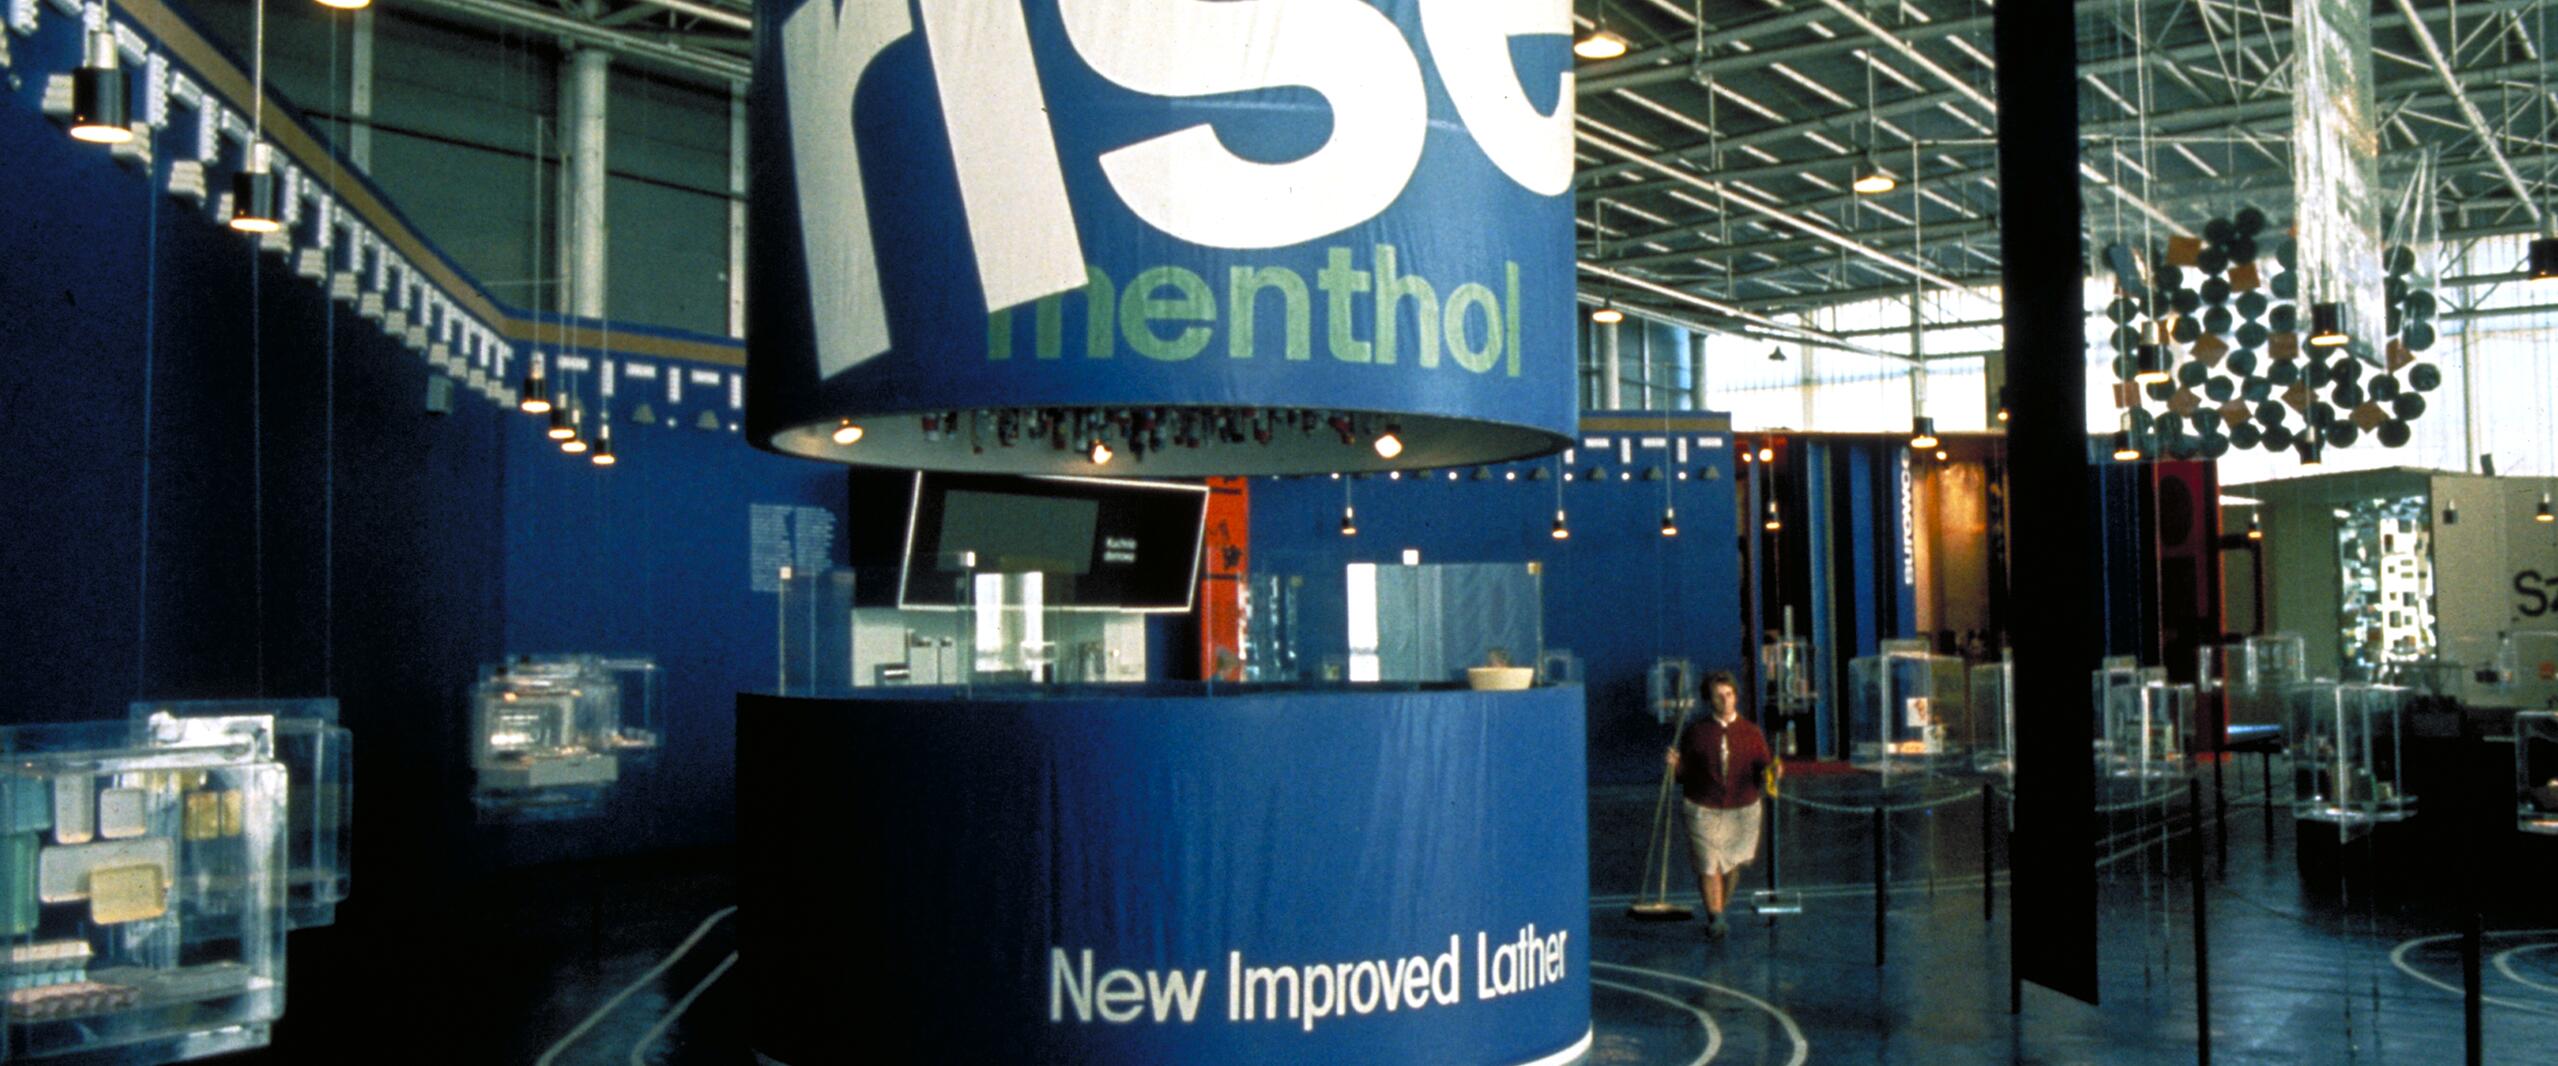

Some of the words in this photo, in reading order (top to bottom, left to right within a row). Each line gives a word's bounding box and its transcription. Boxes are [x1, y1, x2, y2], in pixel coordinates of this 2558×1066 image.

[987, 244, 1521, 378] menthol
[1050, 947, 1206, 1023] New
[1228, 934, 1460, 1031] Improved
[1477, 923, 1568, 999] Lather
